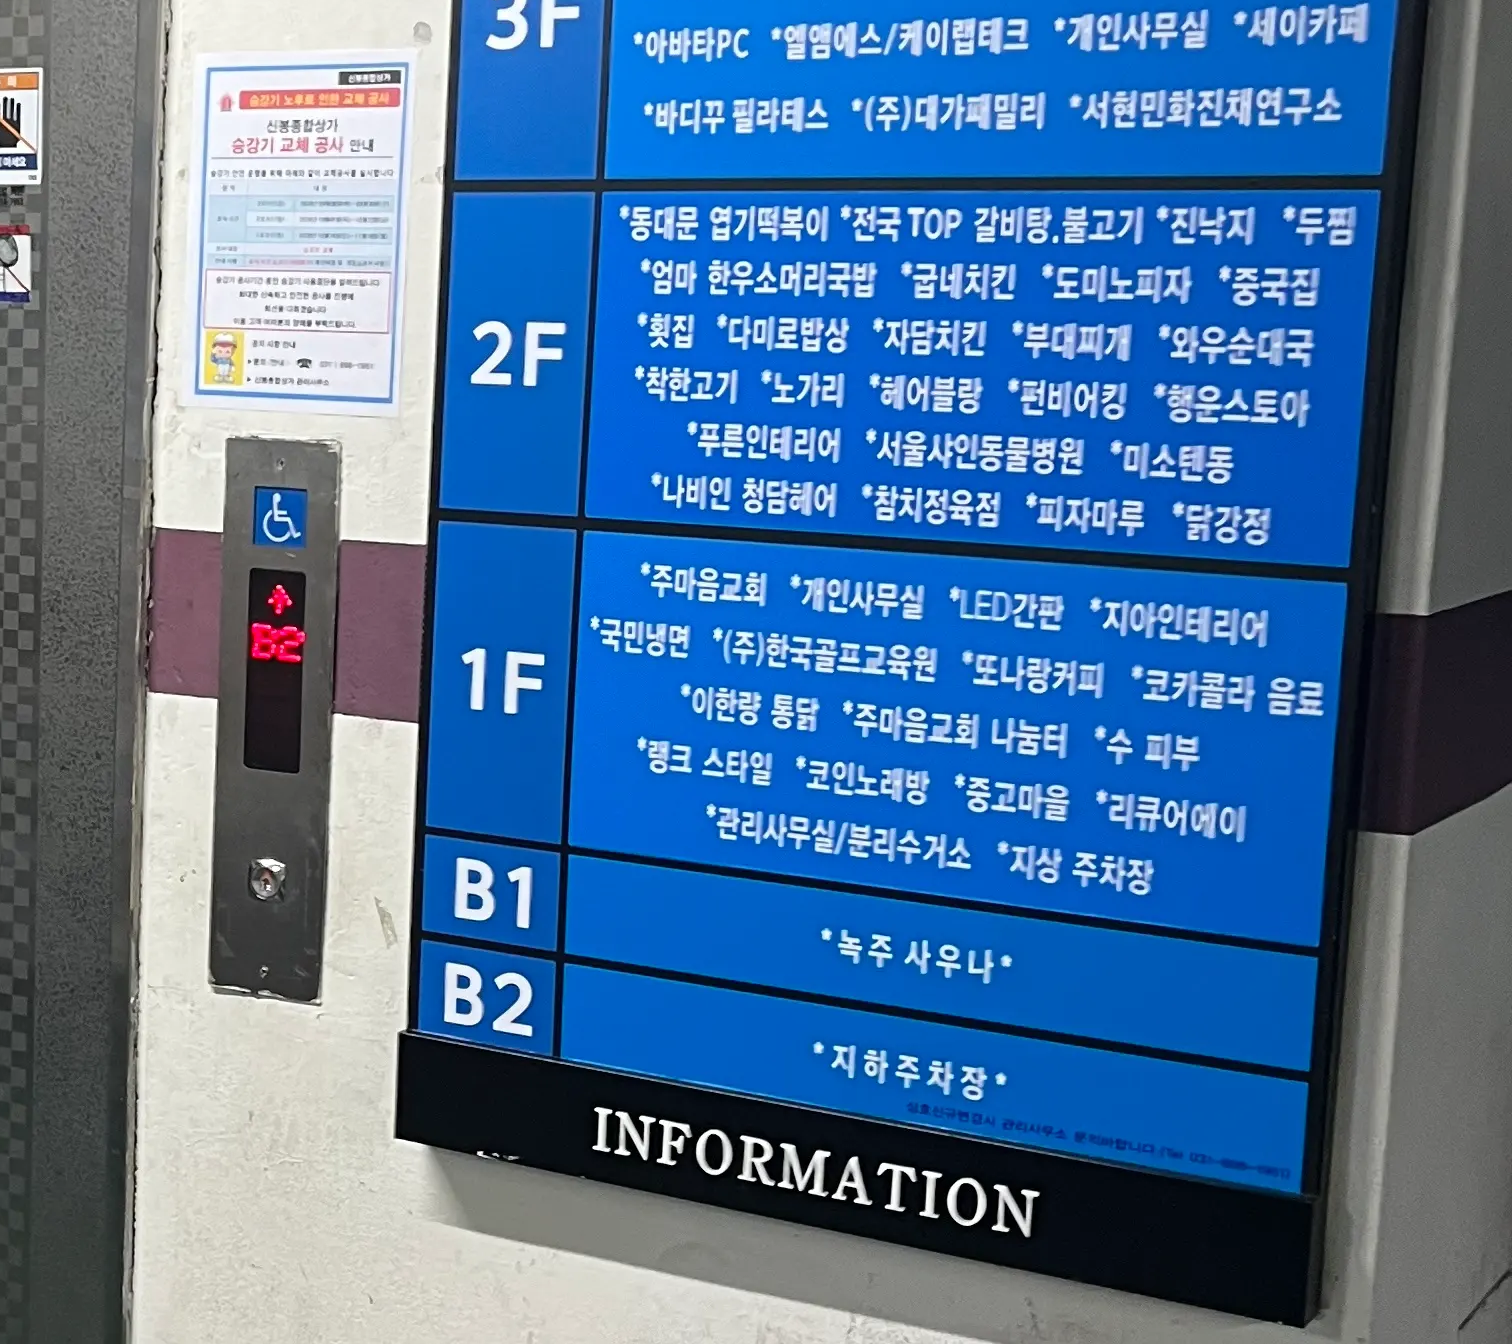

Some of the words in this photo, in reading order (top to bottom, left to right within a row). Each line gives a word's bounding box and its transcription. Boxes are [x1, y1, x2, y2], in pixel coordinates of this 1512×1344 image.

[469, 319, 568, 387] 2F
[250, 622, 305, 662] B2
[460, 646, 546, 715] 1F
[452, 855, 533, 929] B1
[442, 960, 533, 1037] B2
[591, 1105, 1040, 1238] INFORMATION
